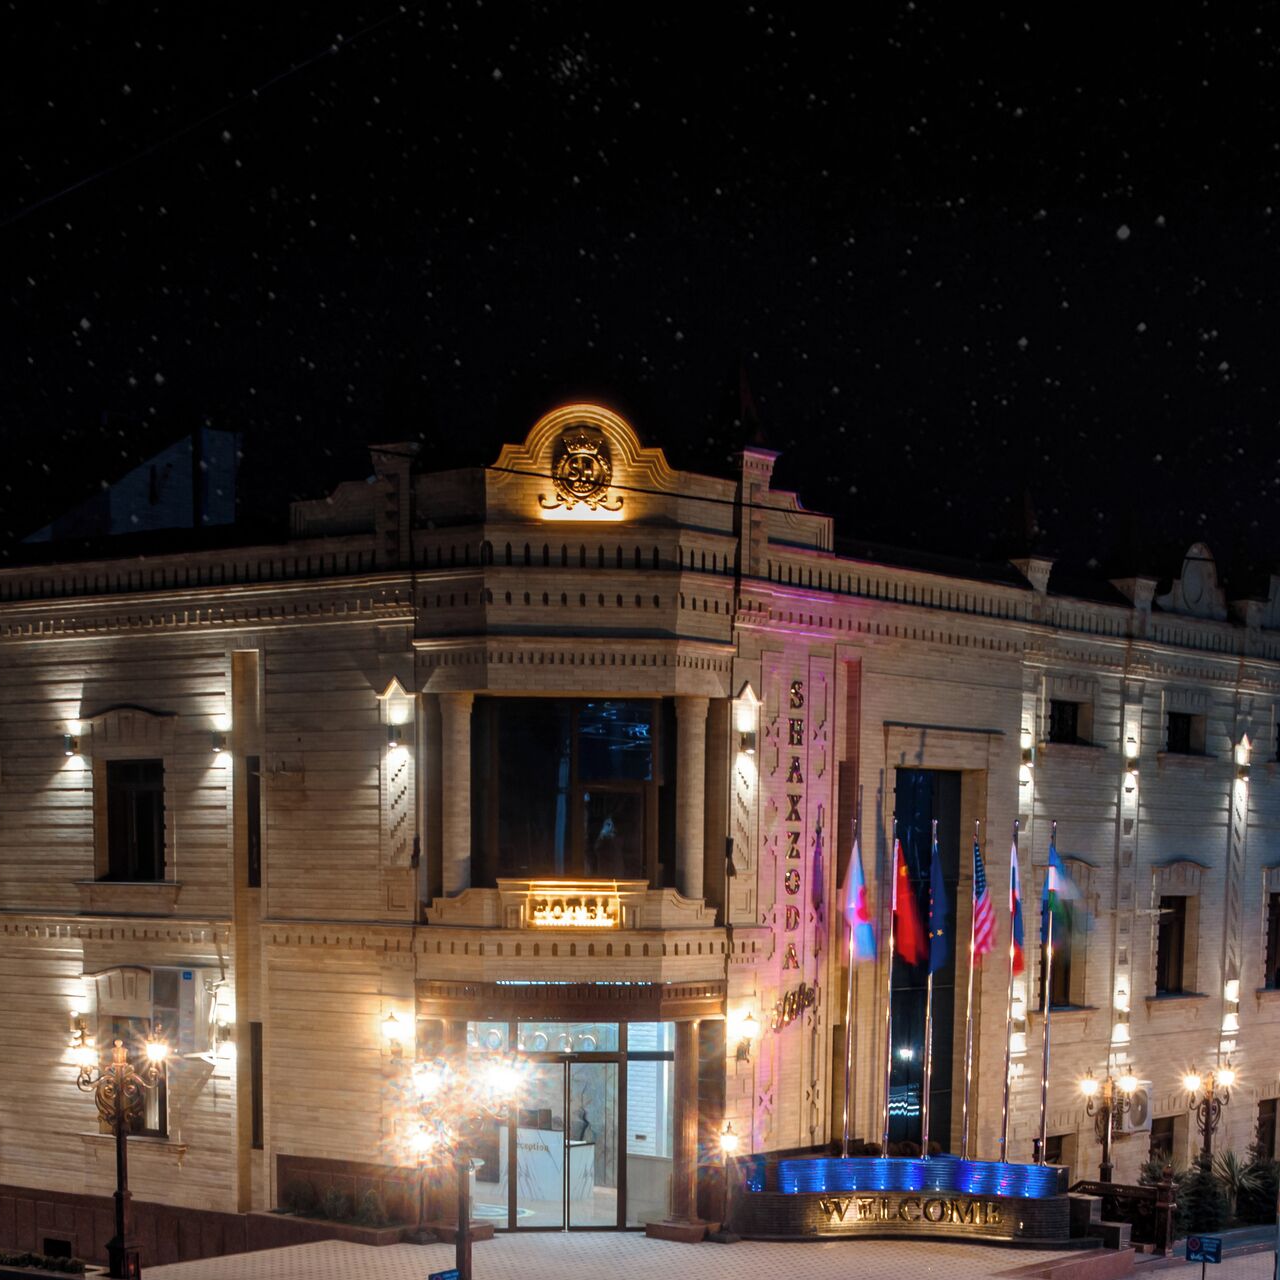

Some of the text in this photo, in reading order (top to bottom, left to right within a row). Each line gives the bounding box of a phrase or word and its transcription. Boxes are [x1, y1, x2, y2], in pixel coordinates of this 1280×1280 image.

[783, 680, 805, 970] SHAXZODA
[517, 1142, 549, 1152] ception
[819, 1196, 1005, 1225] WELCOME
